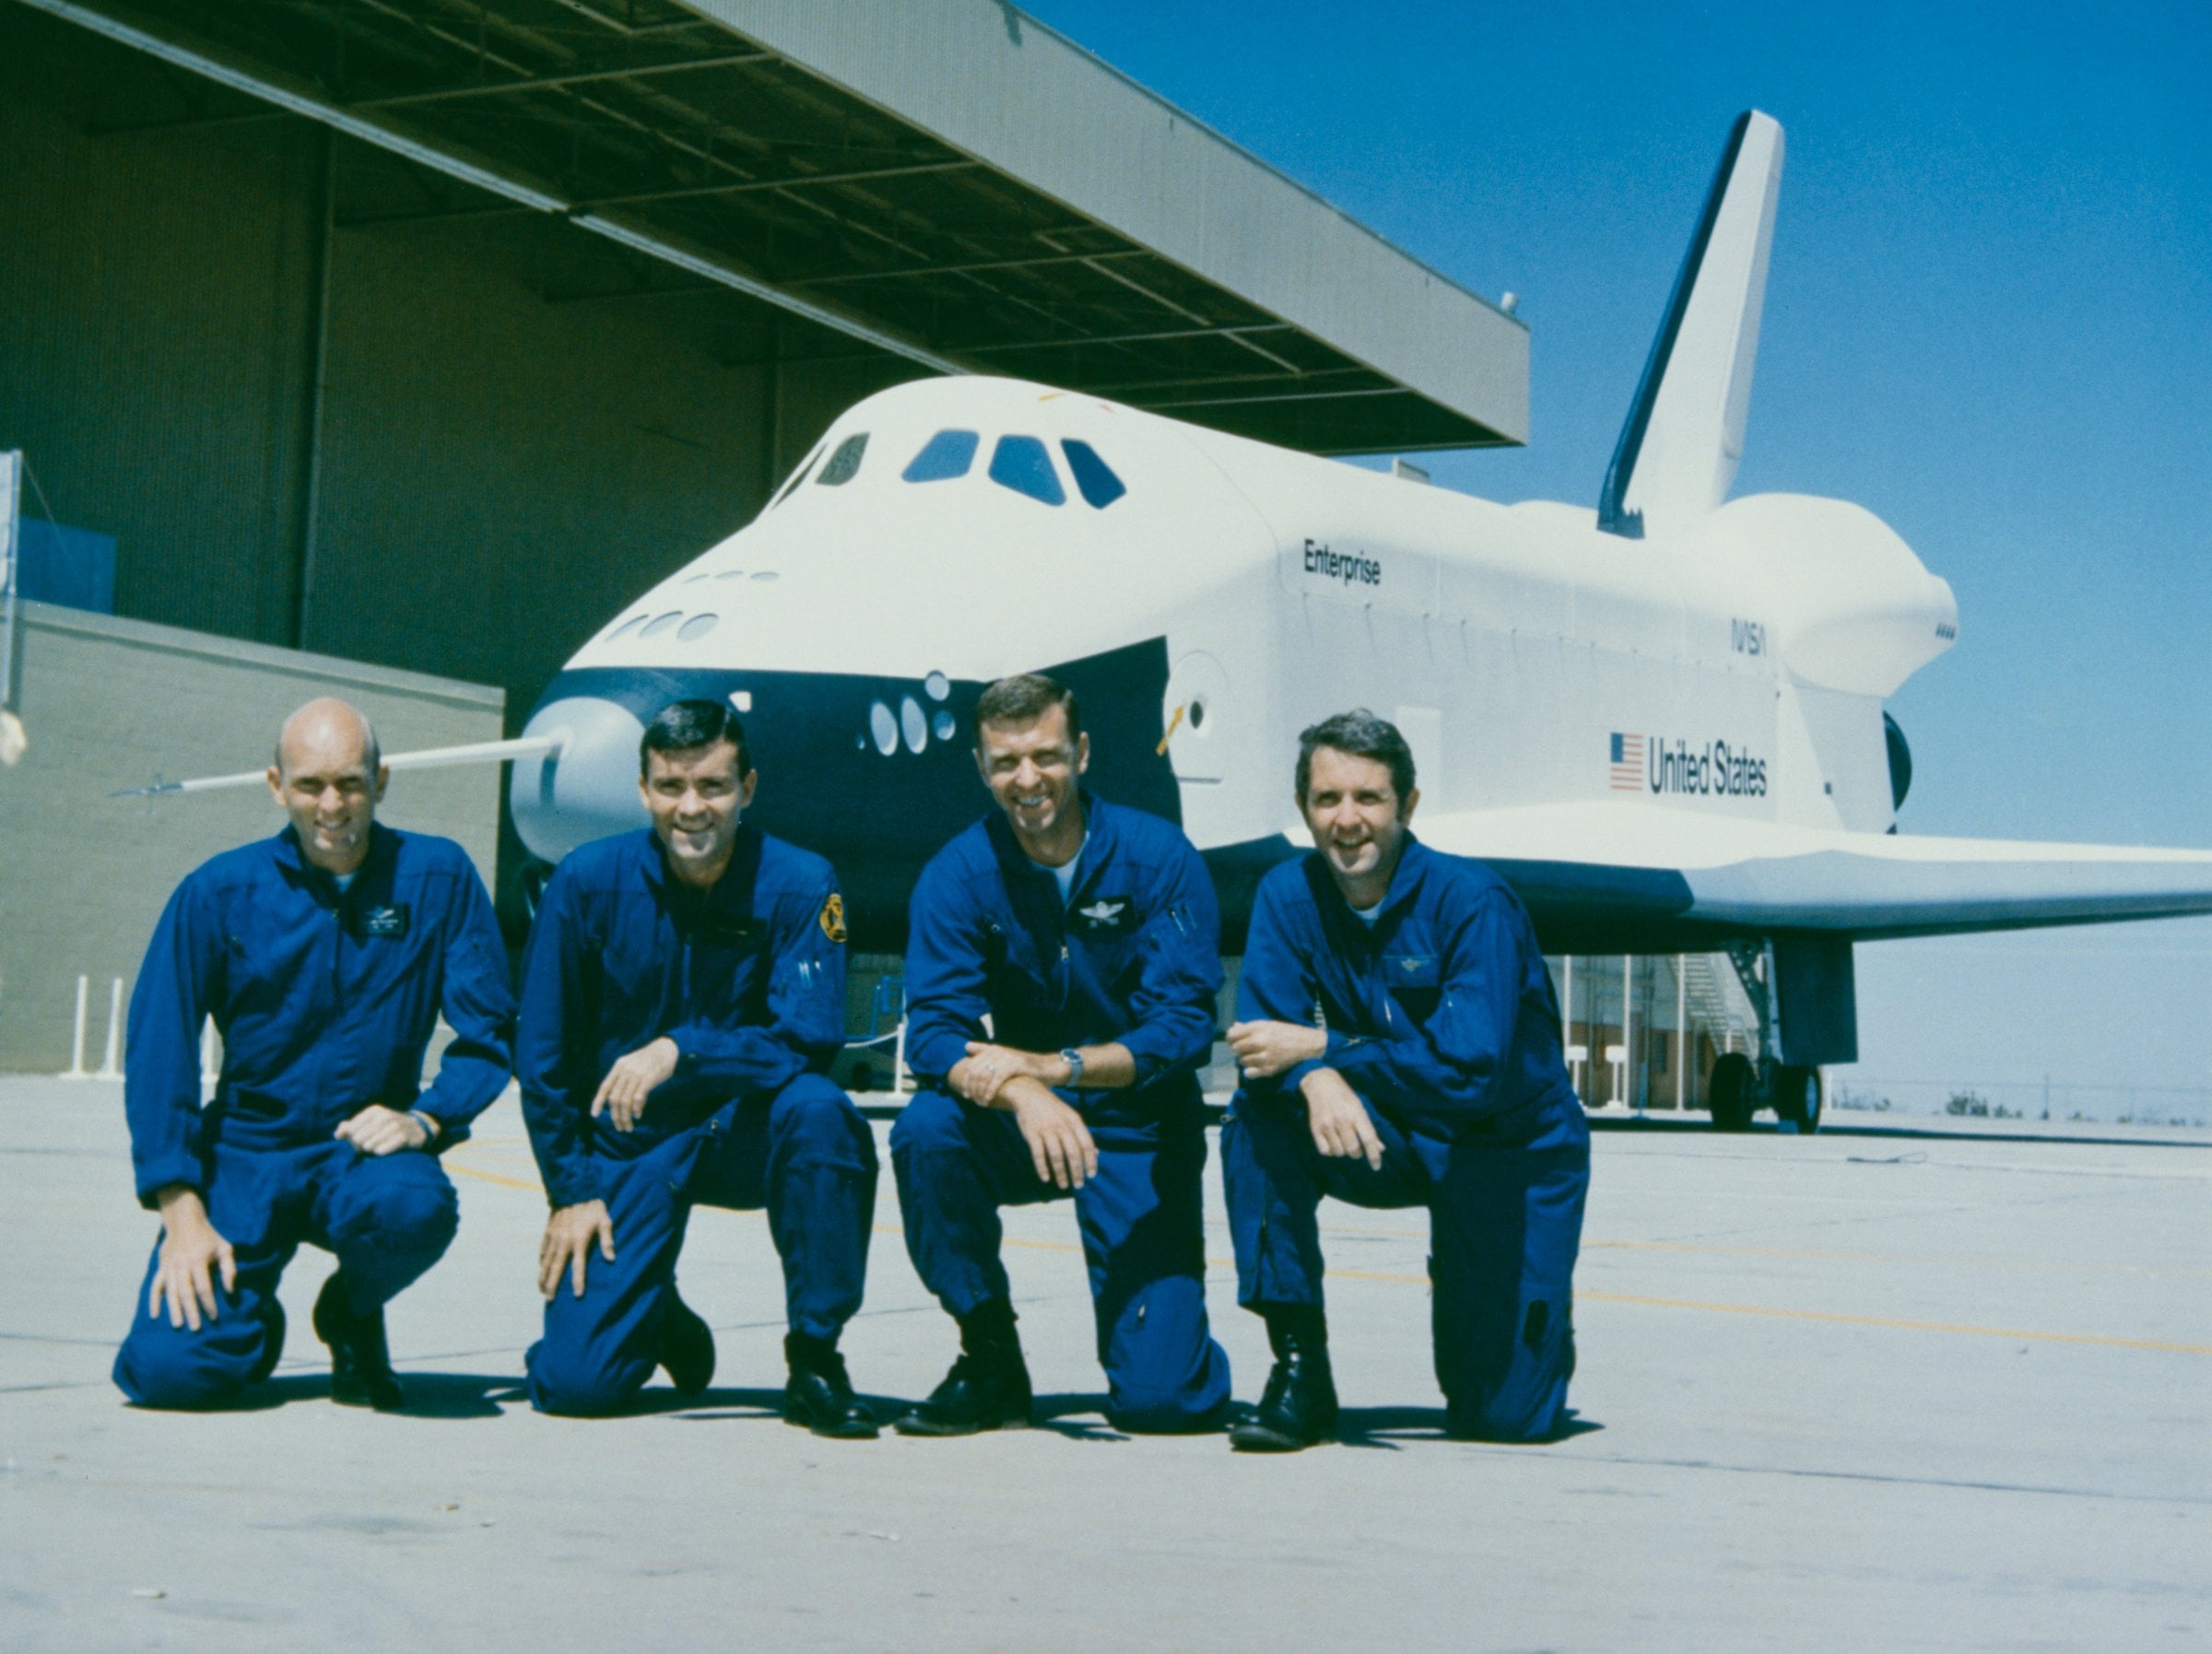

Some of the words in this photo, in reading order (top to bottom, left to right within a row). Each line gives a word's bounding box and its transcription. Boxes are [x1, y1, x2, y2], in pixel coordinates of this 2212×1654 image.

[1304, 538, 1381, 587] Enterprise
[1731, 617, 1767, 657] NASA
[1649, 736, 1711, 794] United
[1714, 739, 1767, 797] States
